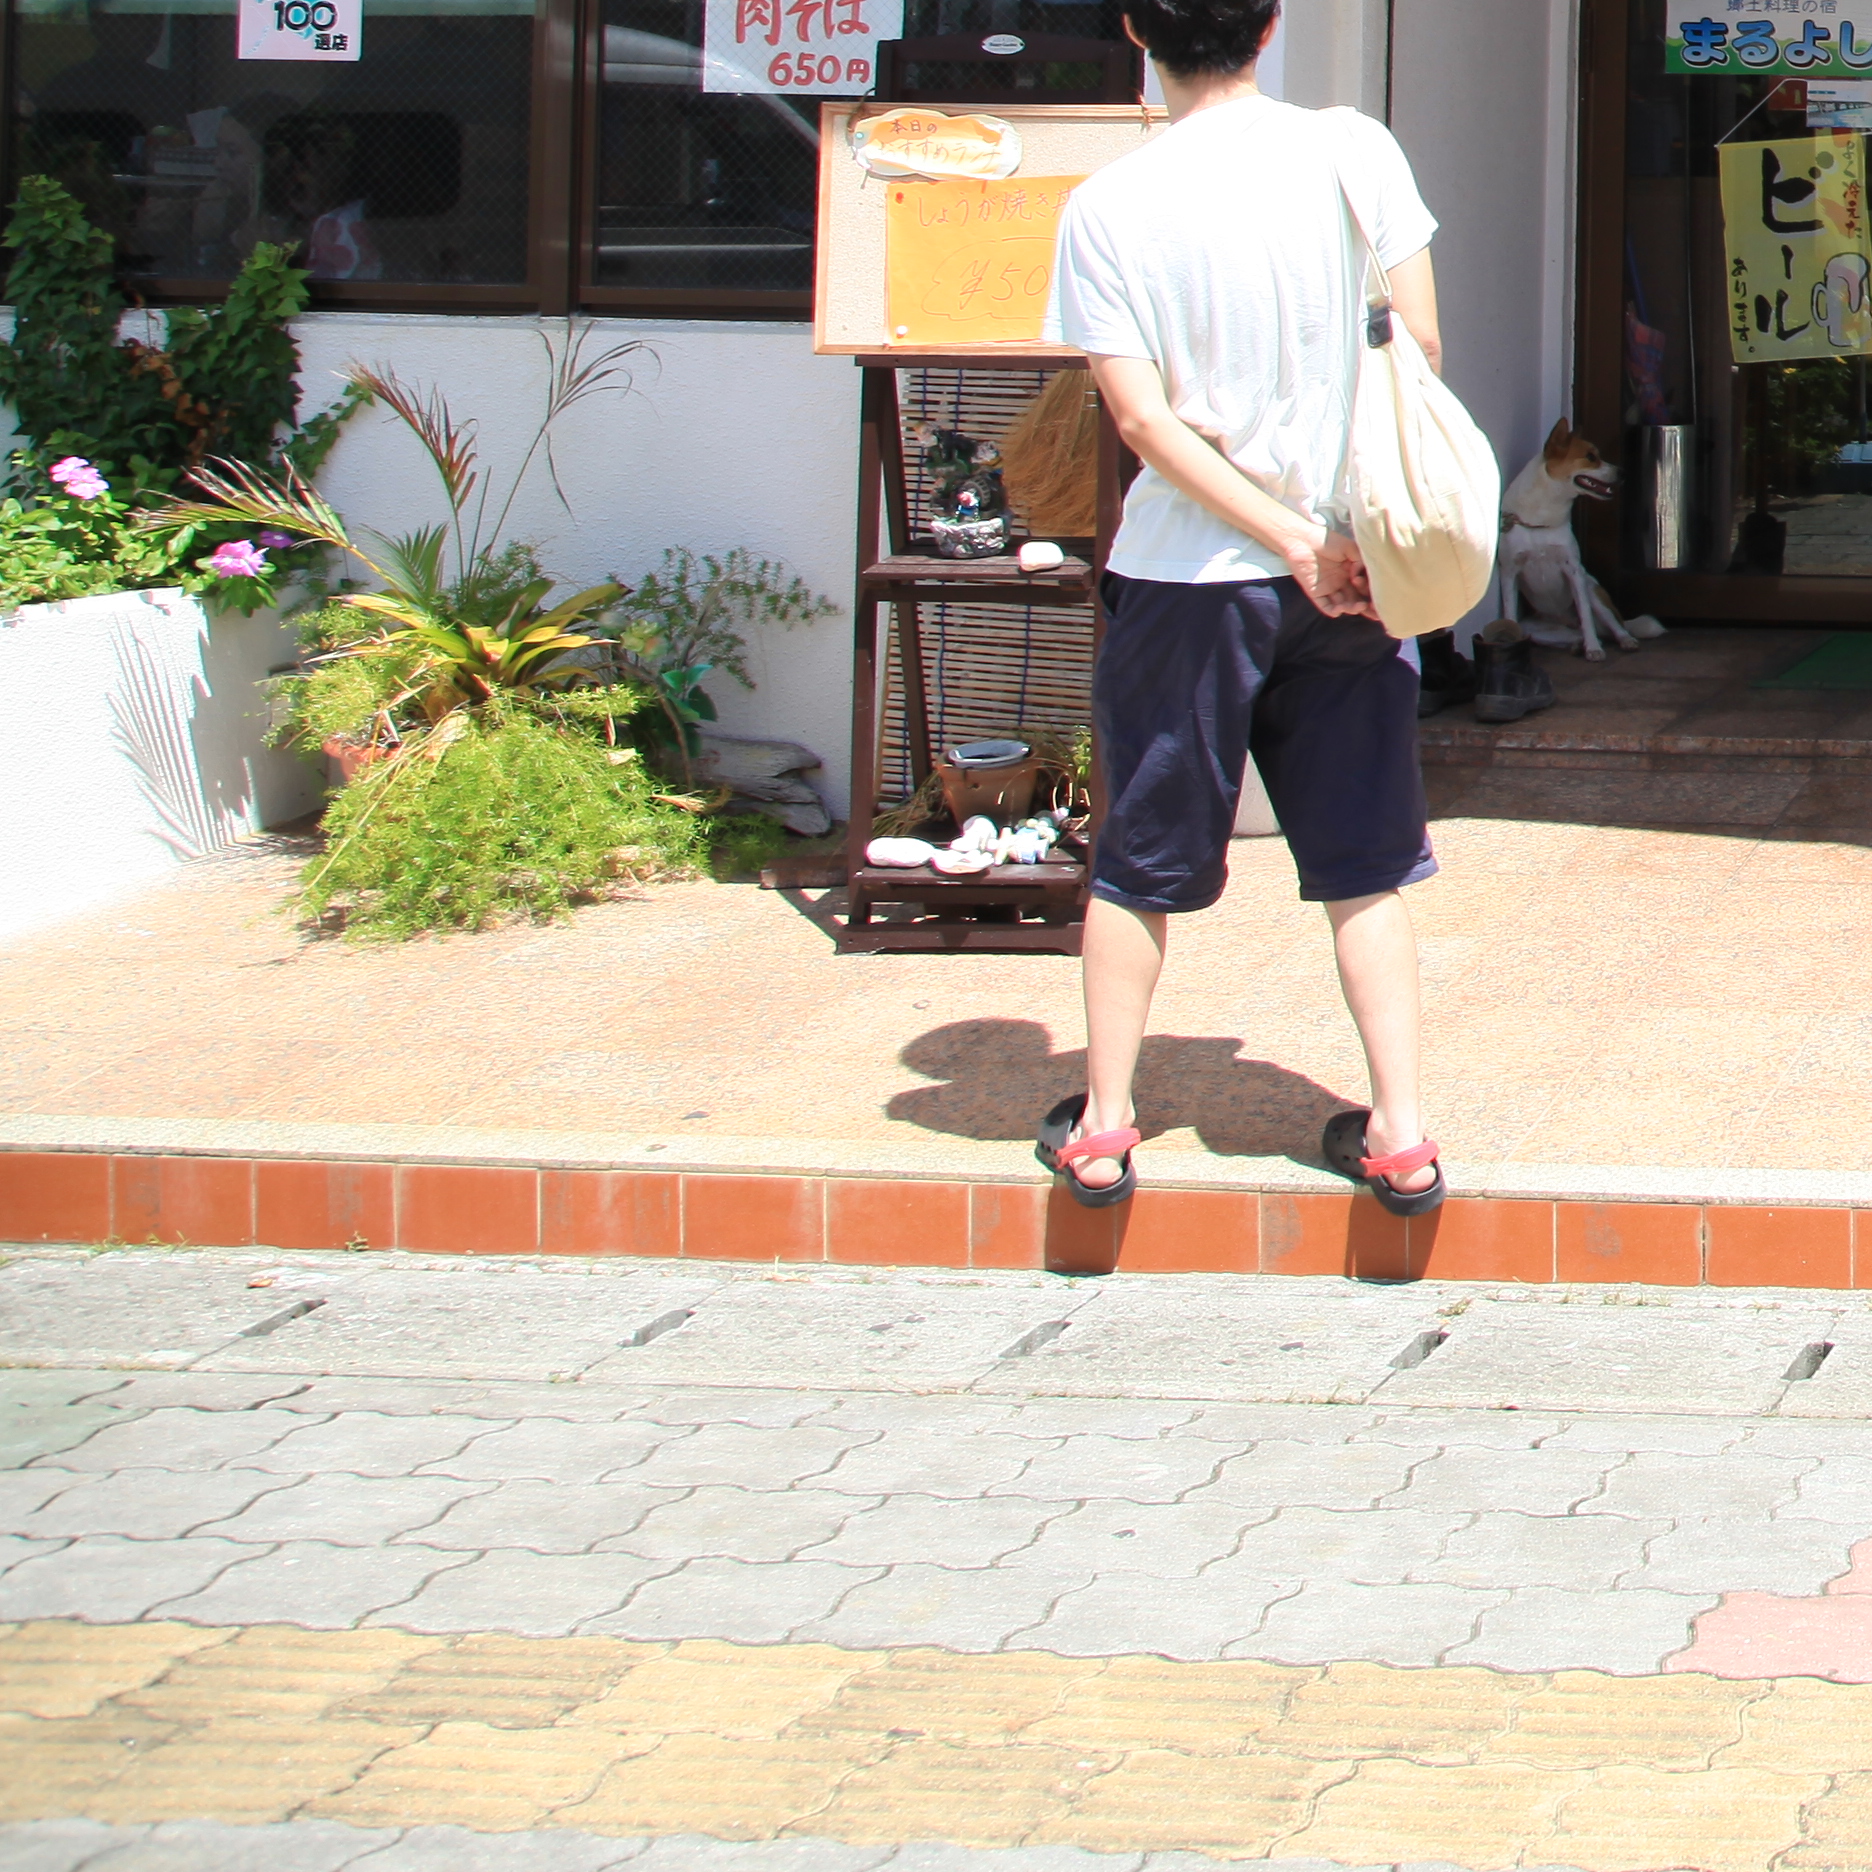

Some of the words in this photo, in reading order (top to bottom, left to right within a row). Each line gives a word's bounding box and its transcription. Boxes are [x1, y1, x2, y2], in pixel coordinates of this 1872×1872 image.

[274, 0, 339, 32] 100
[768, 52, 871, 86] 650円
[890, 119, 938, 134] 本日の
[1755, 147, 1834, 341] ビール
